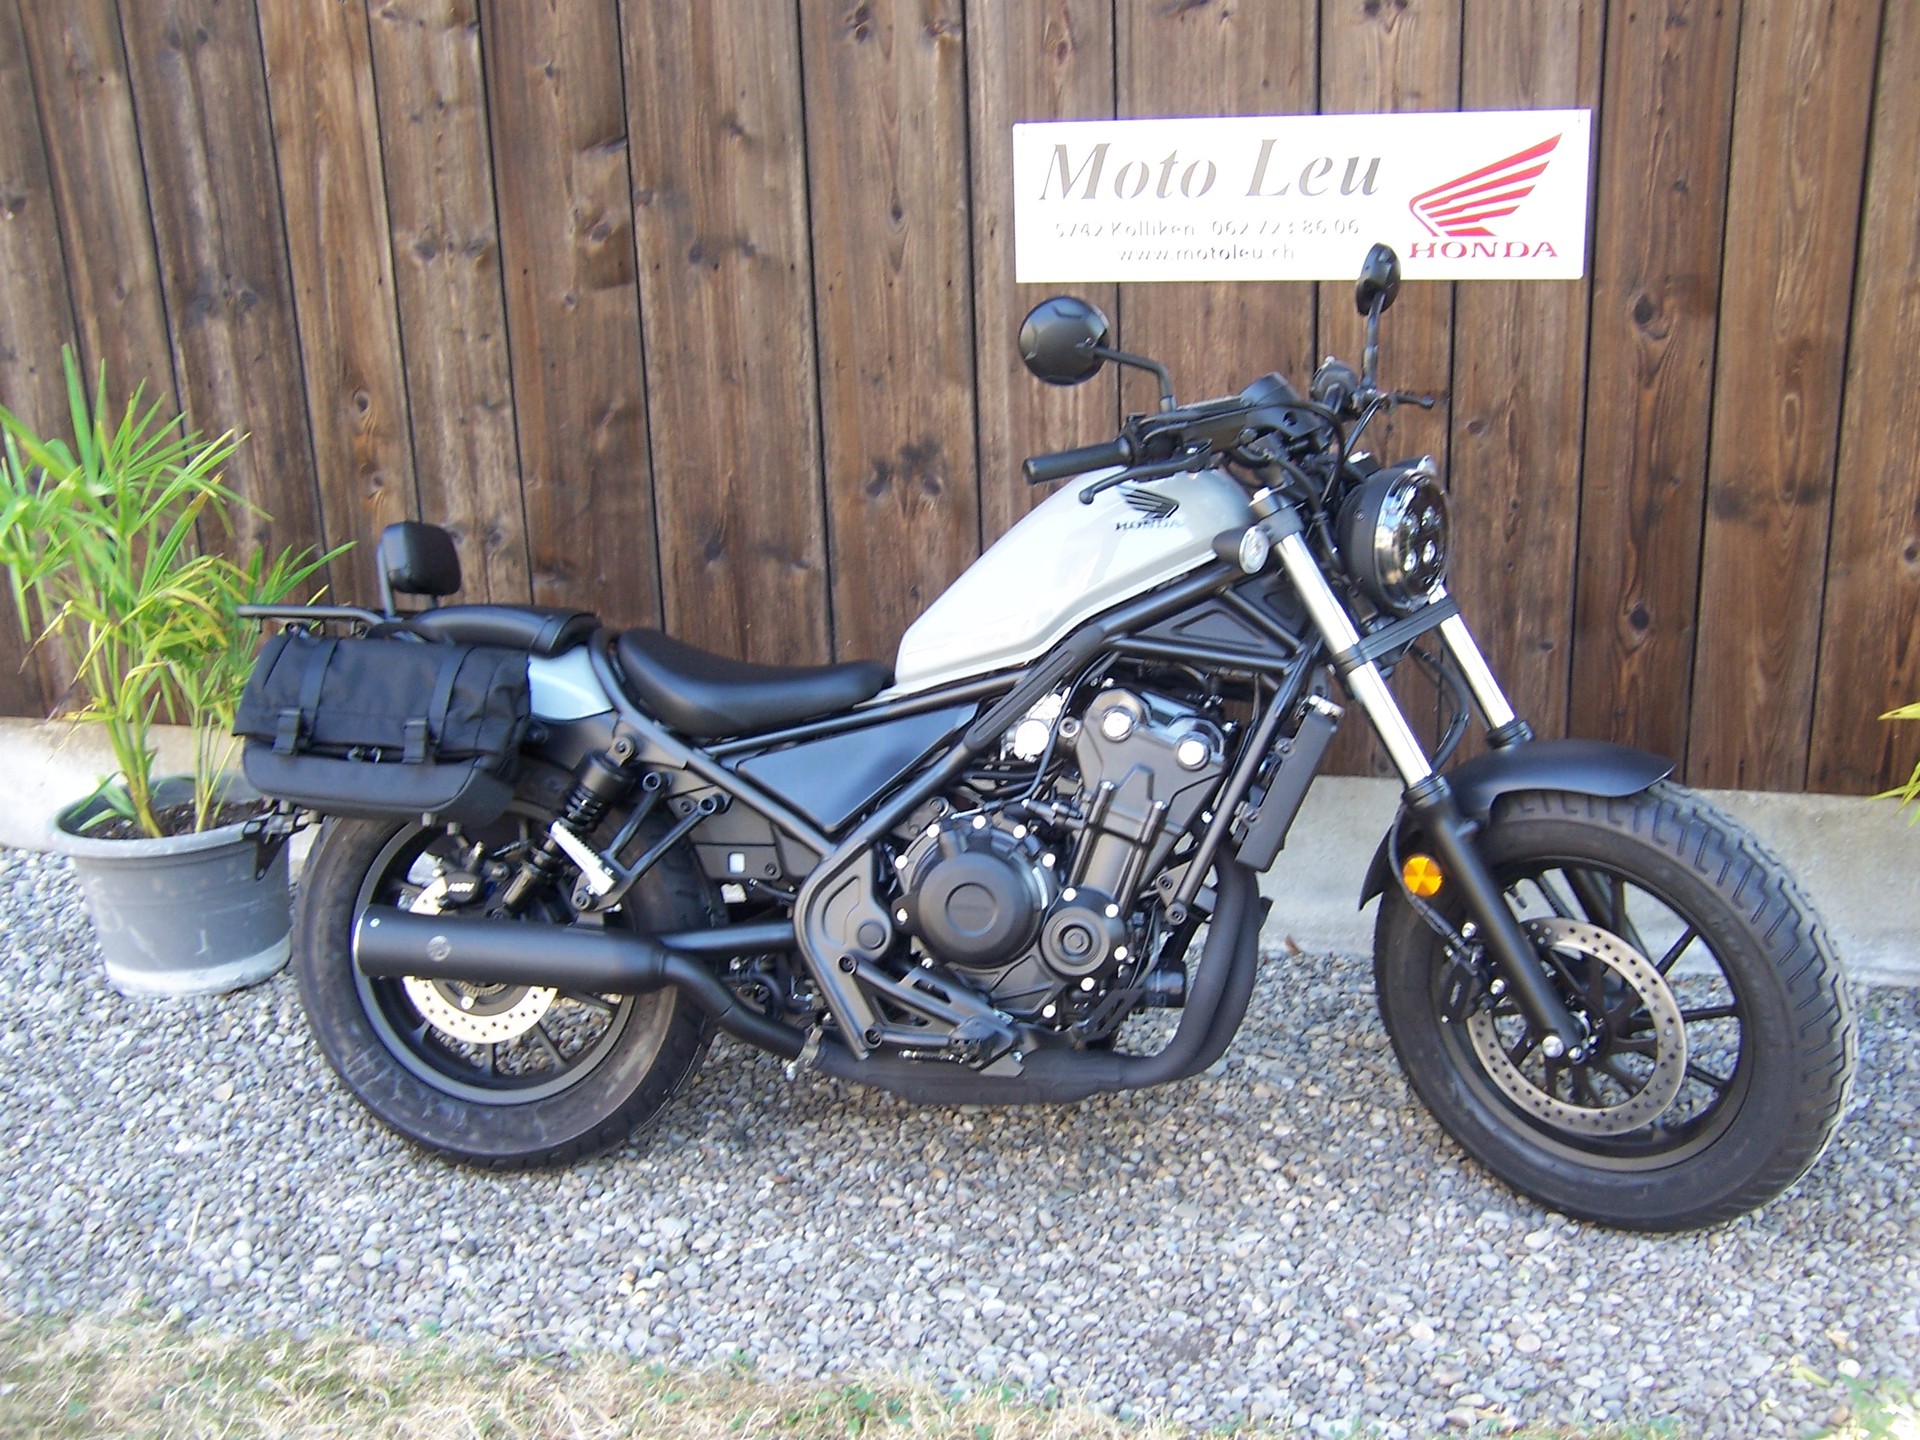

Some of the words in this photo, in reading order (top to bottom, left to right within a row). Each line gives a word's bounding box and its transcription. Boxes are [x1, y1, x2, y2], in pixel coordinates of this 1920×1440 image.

[1038, 142, 1217, 201] Moto
[1244, 138, 1382, 197] Leu
[1211, 220, 1249, 236] 062
[1334, 218, 1359, 235] 06
[1408, 240, 1559, 260] HONDA
